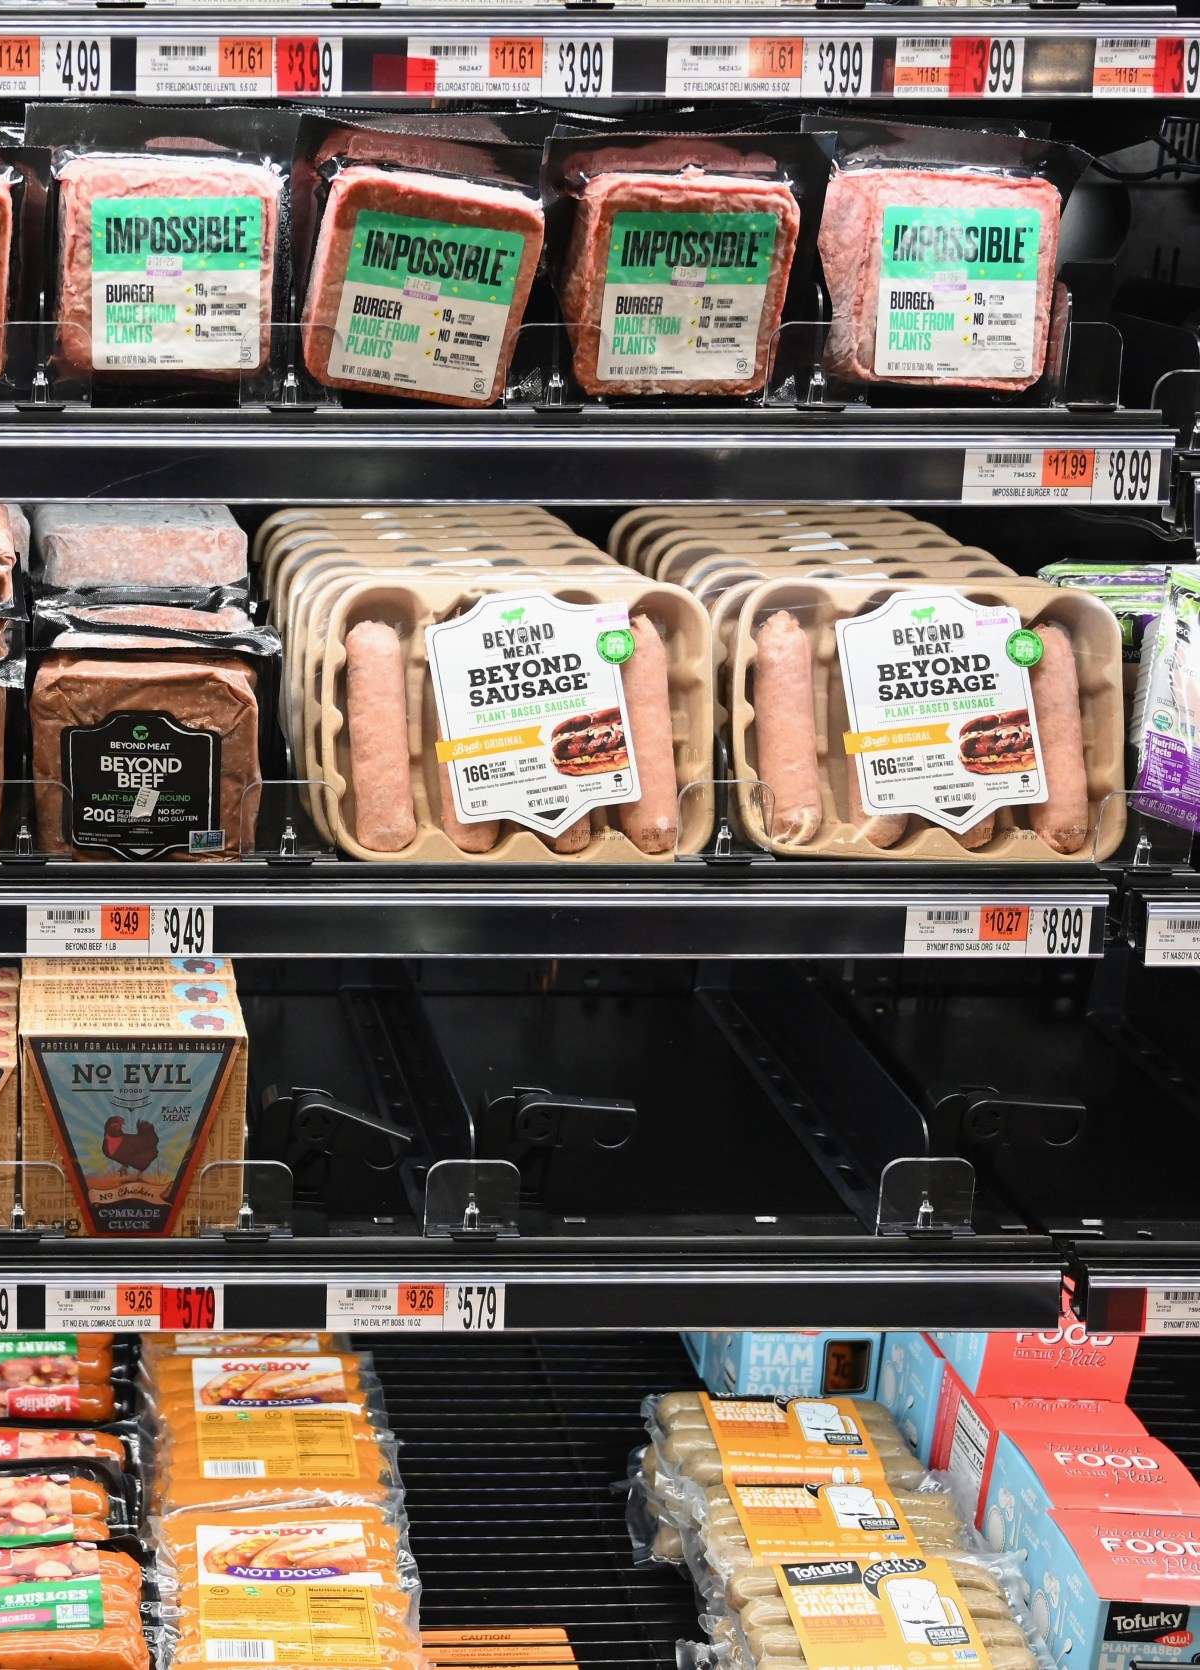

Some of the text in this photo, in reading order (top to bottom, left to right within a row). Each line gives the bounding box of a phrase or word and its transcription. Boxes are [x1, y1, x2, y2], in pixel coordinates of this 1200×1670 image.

[56, 40, 100, 91] $4.99
[224, 47, 263, 70] $11.61
[495, 46, 533, 69] $11.61
[559, 42, 603, 92] $3.99
[818, 41, 863, 92] $3.99
[105, 216, 254, 254] IMPOSSIBLE
[892, 224, 1032, 263] IMPOSSIBLE
[362, 230, 515, 287] IMPOSSIBLE
[621, 230, 768, 268] IMPOSSIBLE
[352, 295, 402, 320] BURGER
[1048, 454, 1087, 476] $11.99
[1109, 450, 1151, 501] $8.99
[992, 488, 1068, 497] IMPOSSIBLE BURGER 12 OZ
[468, 653, 582, 687] BEYOND
[877, 654, 990, 682] BEYOND
[469, 673, 588, 707] SAUSAGE
[878, 673, 997, 702] SAUSAGE
[884, 697, 995, 718] PLANT-BASED SAUSAGE
[100, 756, 182, 773] BEYOND
[463, 763, 490, 784] 16G
[117, 772, 164, 788] BEEF
[110, 911, 139, 932] $9.49
[164, 907, 205, 954] $9.49
[986, 912, 1022, 932] $10.27
[1043, 908, 1083, 954] $8.99
[124, 1063, 192, 1084] EVIL
[98, 1208, 160, 1218] COMRADE
[108, 1219, 150, 1229] CLUCK
[124, 1290, 153, 1309] $9.26
[457, 1286, 496, 1329] $5.79
[353, 1319, 360, 1327] ST
[360, 1319, 369, 1327] NO
[370, 1319, 381, 1327] EVIL
[390, 1319, 405, 1327] BOSS
[408, 1319, 414, 1327] 10
[414, 1319, 421, 1327] OZ
[749, 1342, 813, 1364] HAM
[748, 1366, 813, 1381] STYLE
[1053, 1451, 1159, 1470] FOOD
[234, 1566, 275, 1576] NOT
[787, 1561, 853, 1580] Tofurky
[802, 1602, 878, 1616] SAUSAGE
[1113, 1611, 1183, 1631] Tofurky
[1102, 1643, 1181, 1655] PLANT-BASED
